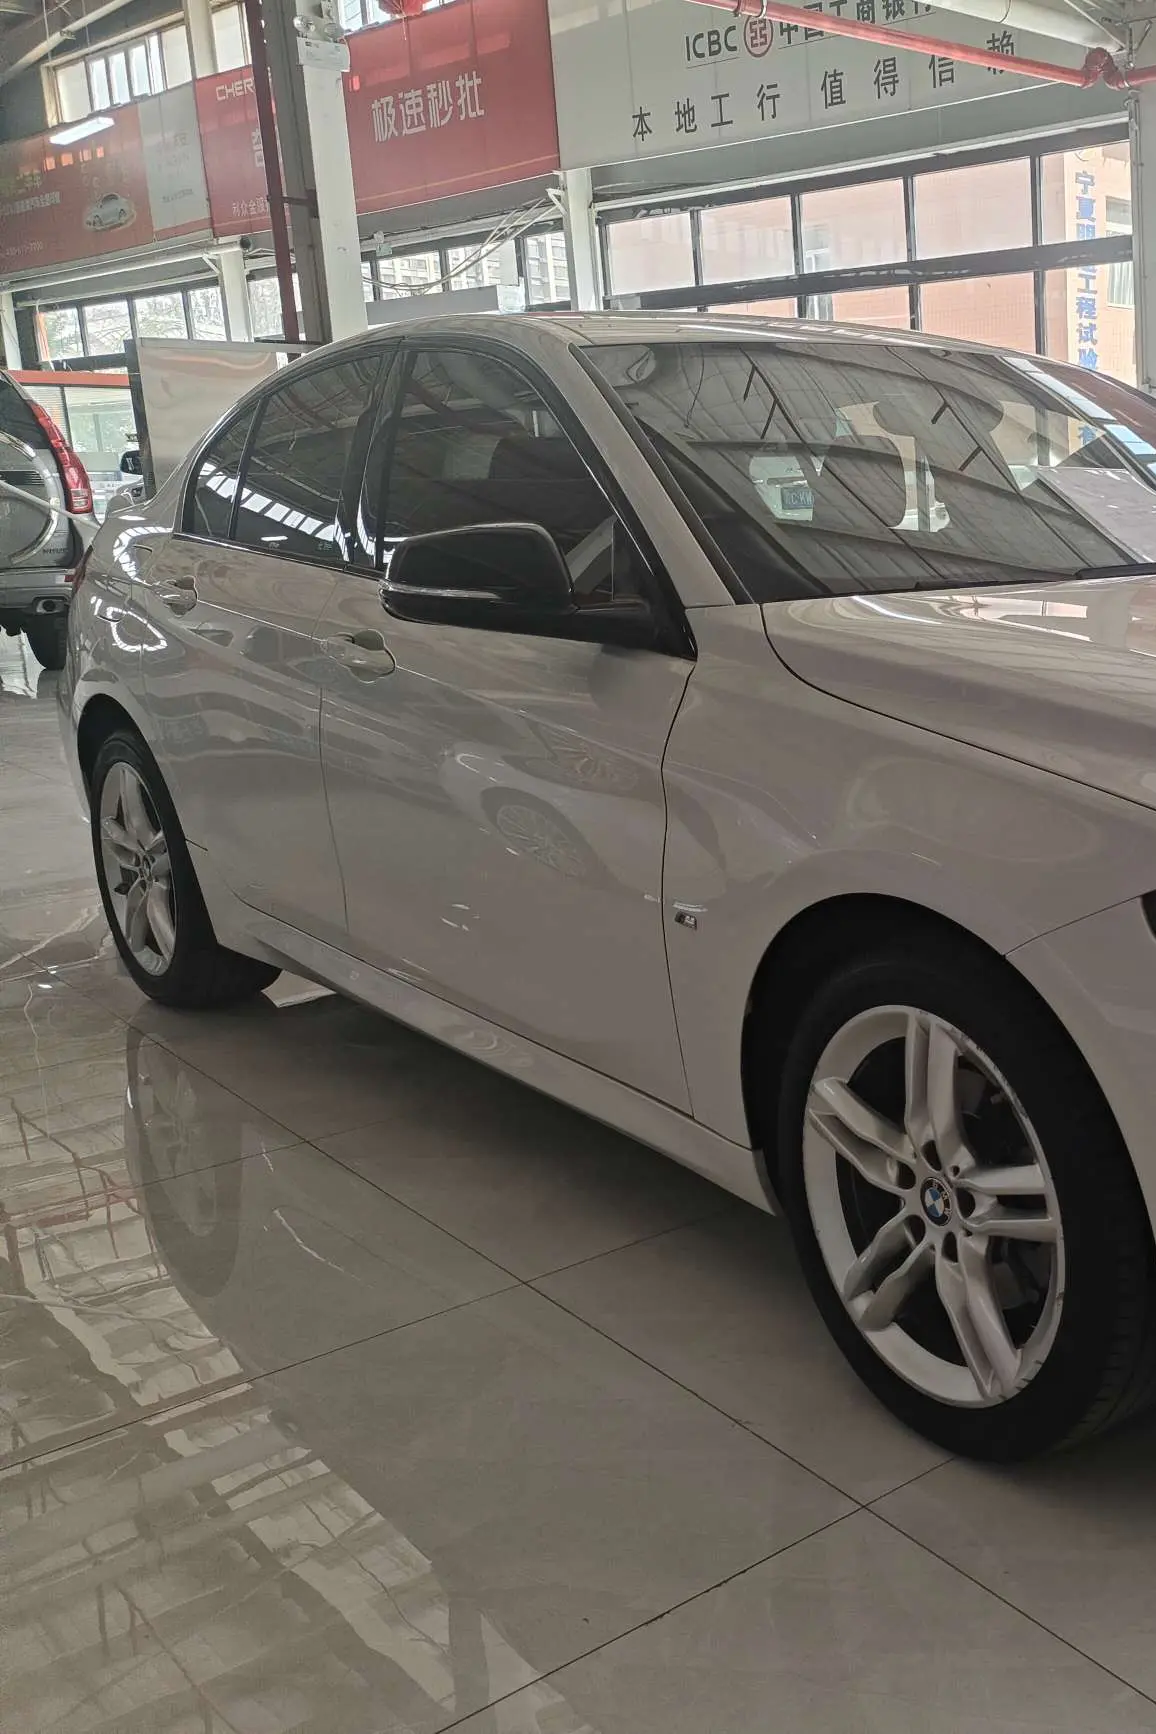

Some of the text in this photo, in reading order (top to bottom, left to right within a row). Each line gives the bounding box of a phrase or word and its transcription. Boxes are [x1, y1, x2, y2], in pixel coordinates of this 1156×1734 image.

[685, 25, 738, 62] ICBC
[215, 78, 257, 101] CHER
[371, 70, 485, 143] 极速秒批
[631, 29, 1016, 142] 本地工行 值得信赖
